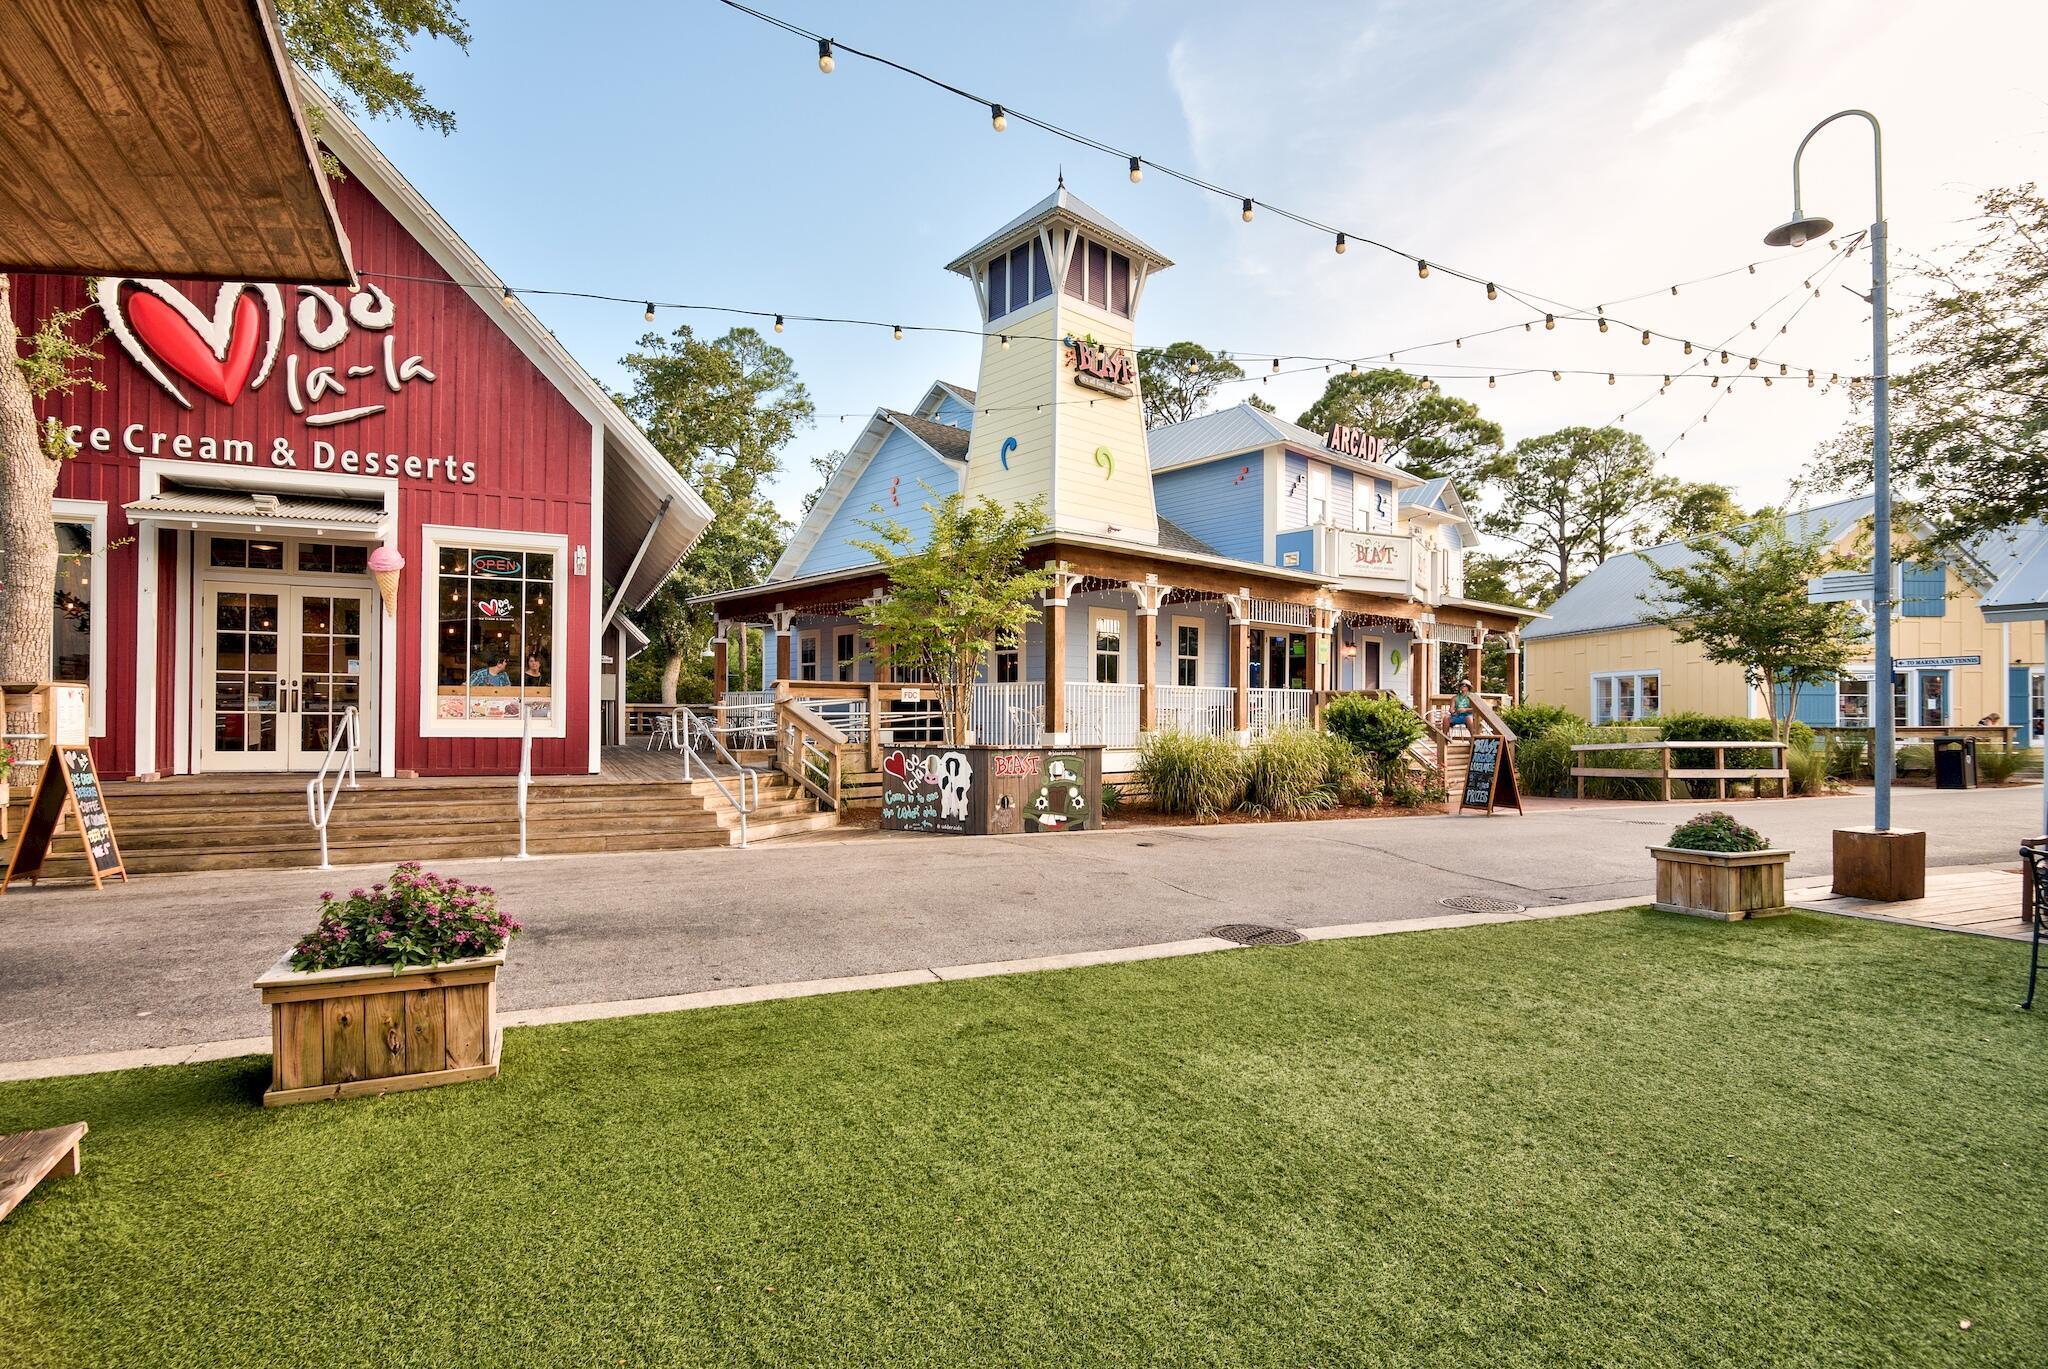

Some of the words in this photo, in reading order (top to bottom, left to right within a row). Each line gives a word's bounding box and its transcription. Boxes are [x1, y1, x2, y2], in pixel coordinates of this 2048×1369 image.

[123, 424, 253, 463] Cream
[271, 437, 297, 467] &
[313, 440, 476, 484] Desserts
[1331, 423, 1385, 464] ARCADE
[475, 559, 516, 570] OPEN
[904, 691, 918, 699] FDC
